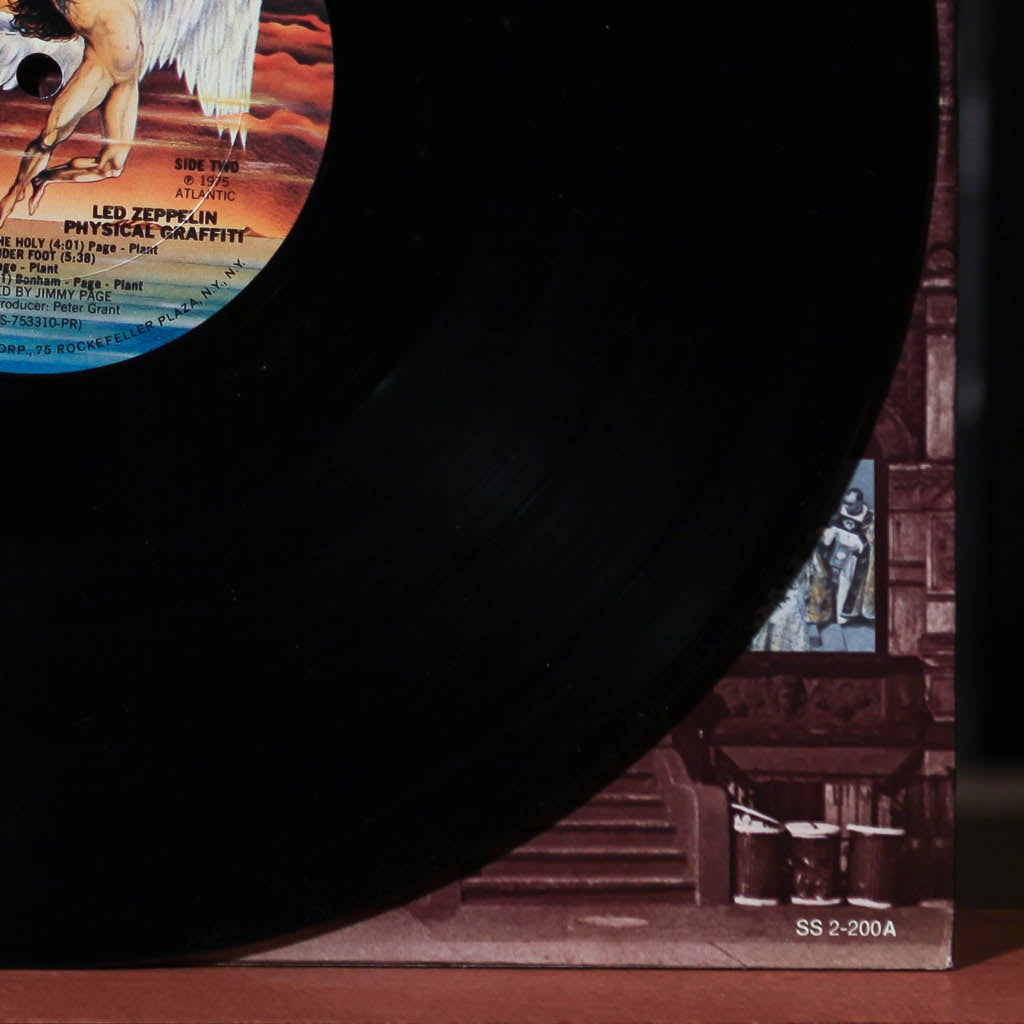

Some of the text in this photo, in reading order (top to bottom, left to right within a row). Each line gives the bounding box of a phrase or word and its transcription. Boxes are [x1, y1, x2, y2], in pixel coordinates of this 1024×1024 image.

[175, 158, 239, 173] SIDE TWO
[175, 188, 236, 201] ATLANTIC
[93, 204, 218, 225] LED ZEPPELIN
[64, 220, 155, 239] PHYSICAL
[16, 237, 46, 249] HOLY
[49, 239, 85, 253] (4:01)
[88, 241, 117, 254] Page
[129, 243, 158, 255] Plant
[28, 249, 56, 261] FOOT
[60, 252, 96, 265] (5:38)
[29, 262, 59, 274] Plant
[15, 274, 61, 287] Bonham
[73, 277, 102, 292] Page
[114, 279, 144, 292] Plant
[15, 287, 31, 298] BY
[34, 288, 75, 300] JIMMY
[79, 290, 112, 302] PAGE
[53, 301, 84, 313] Peter
[87, 303, 121, 315] Grant
[36, 345, 52, 355] 75
[56, 320, 154, 354] ROCKEFELLER
[158, 298, 203, 326] PLAZA,
[795, 919, 896, 937] SS 2-200A
